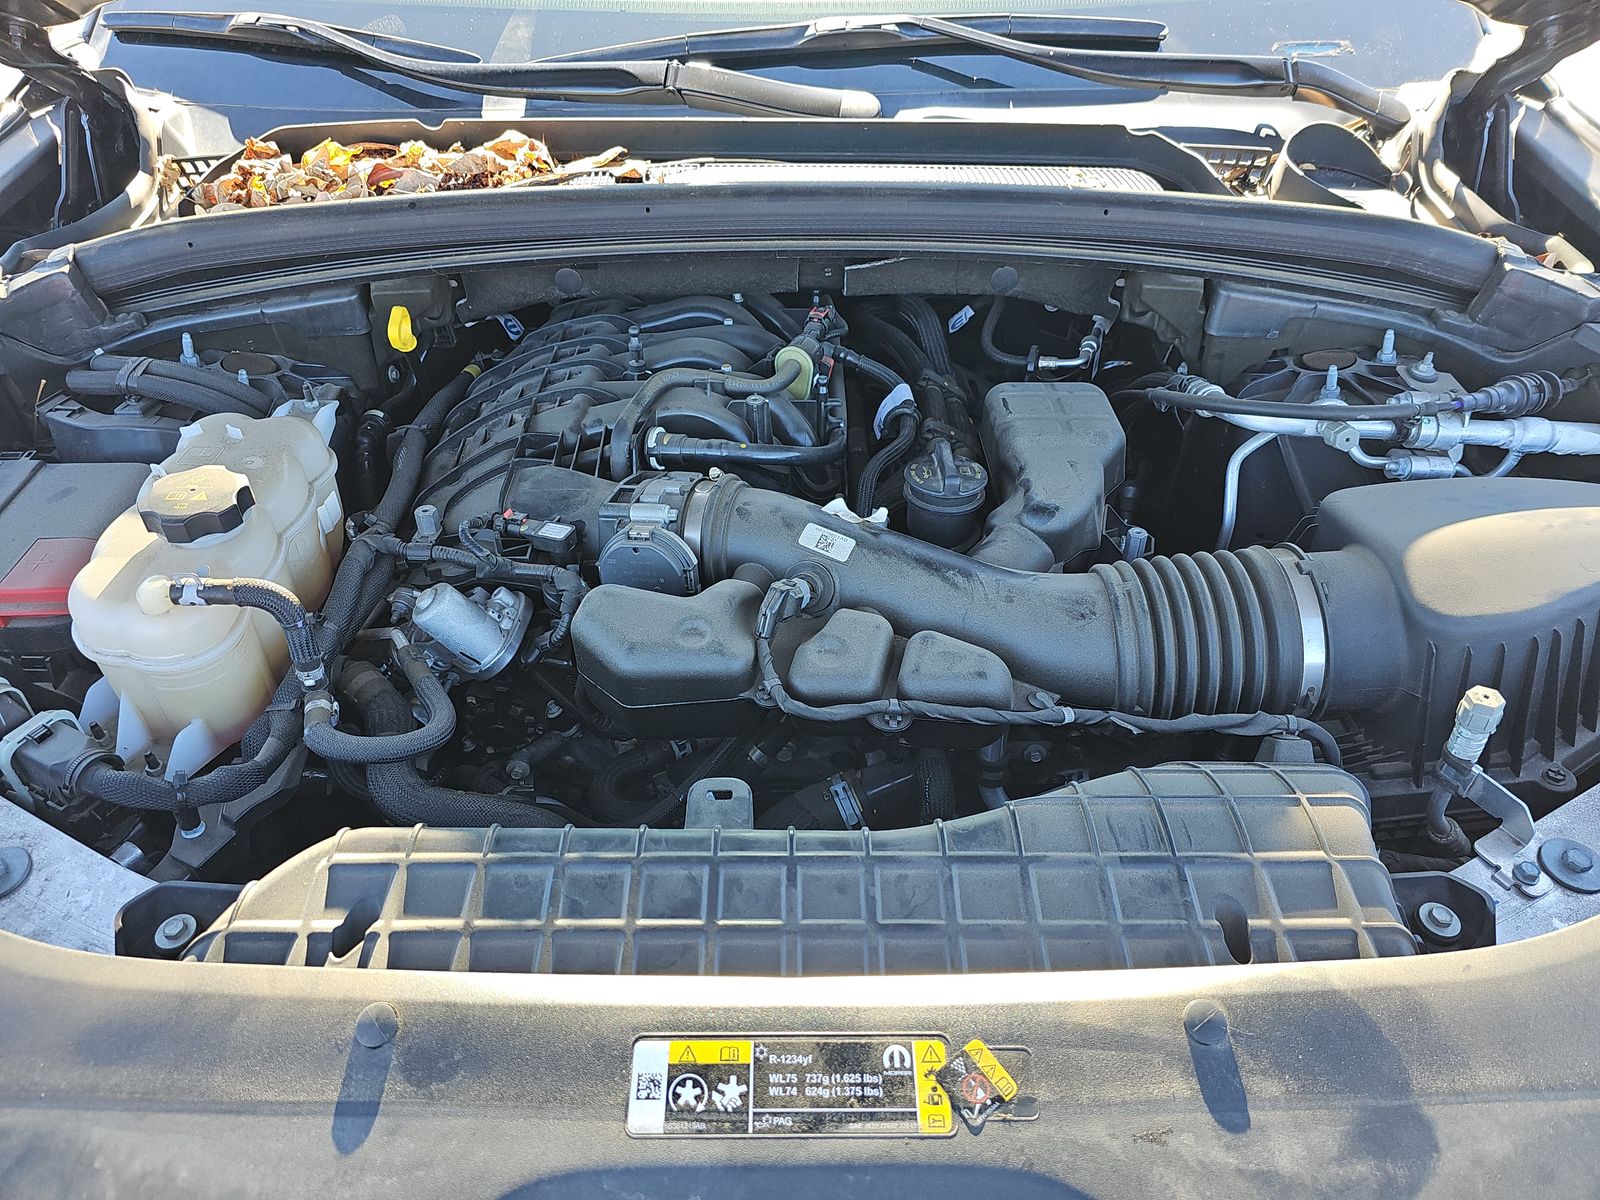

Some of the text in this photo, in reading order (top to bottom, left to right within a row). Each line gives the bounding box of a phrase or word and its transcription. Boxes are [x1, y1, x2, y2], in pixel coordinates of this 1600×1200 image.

[769, 1054, 813, 1066] R-1234yf
[769, 1073, 883, 1085] WL75 737g (1.625 lbs)
[769, 1086, 884, 1098] WL74 624g (1.375 lbs)
[773, 1117, 793, 1126] PAG
